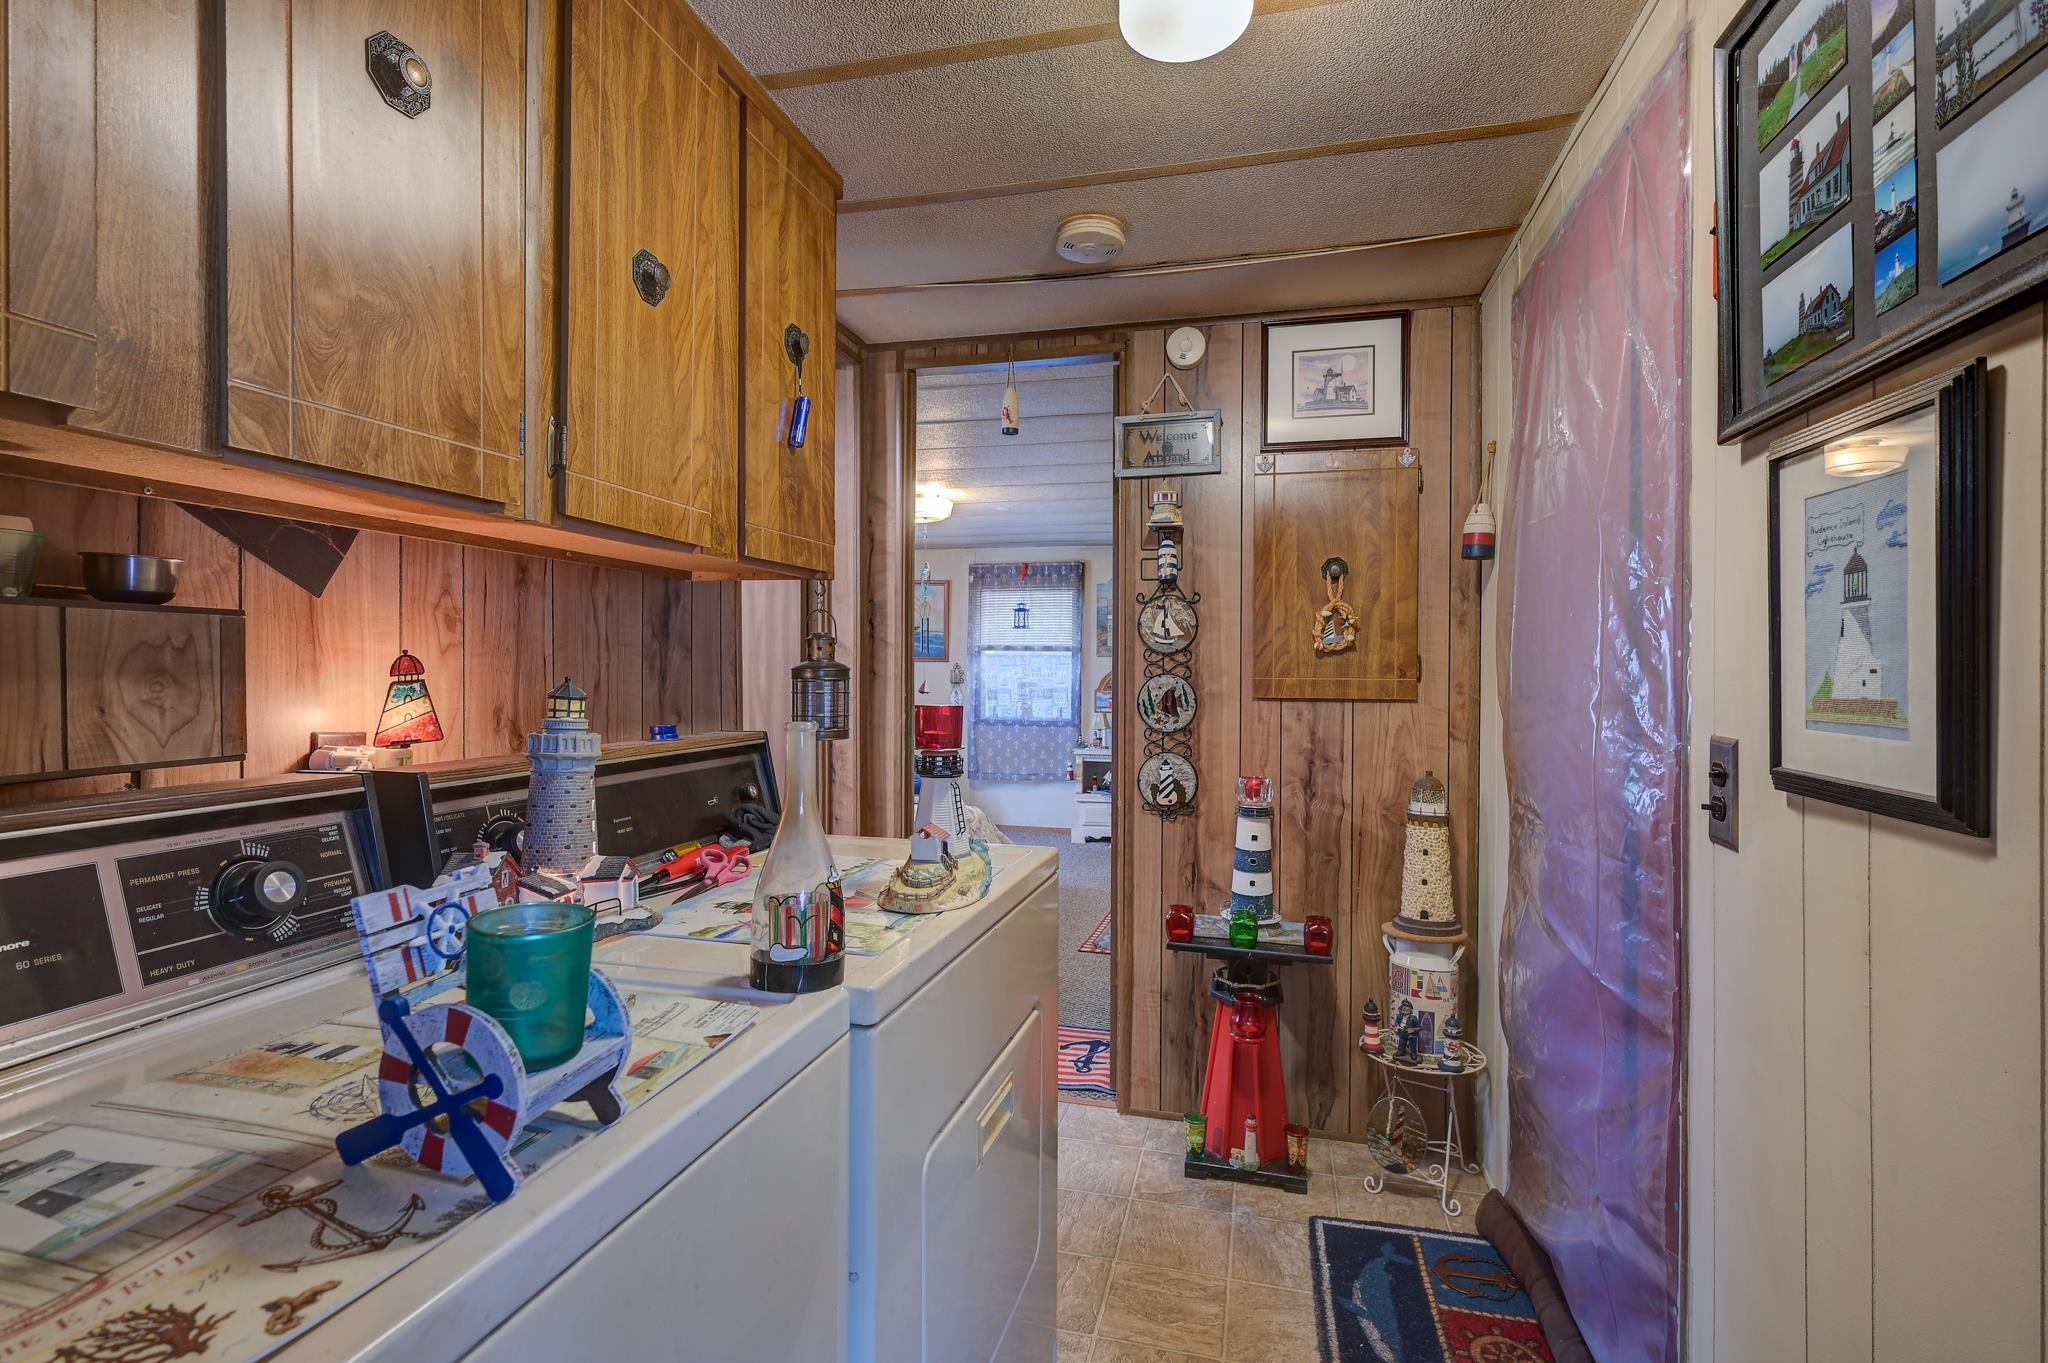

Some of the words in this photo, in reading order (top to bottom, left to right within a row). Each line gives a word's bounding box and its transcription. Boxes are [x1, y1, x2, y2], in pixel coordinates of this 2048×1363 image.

[1138, 429, 1198, 444] Welcome
[1144, 449, 1190, 464] Aboard
[320, 850, 342, 858] NORMAL
[129, 872, 175, 886] PERMANENT
[177, 867, 200, 877] PRESS
[324, 876, 350, 888] PREWASH
[136, 902, 162, 913] DELICATE
[139, 913, 164, 923] REGULAR
[16, 960, 30, 970] 60
[34, 953, 62, 966] SERIES
[149, 965, 174, 977] HEAVY
[176, 959, 195, 970] DUTY
[202, 970, 226, 981] WASHING
